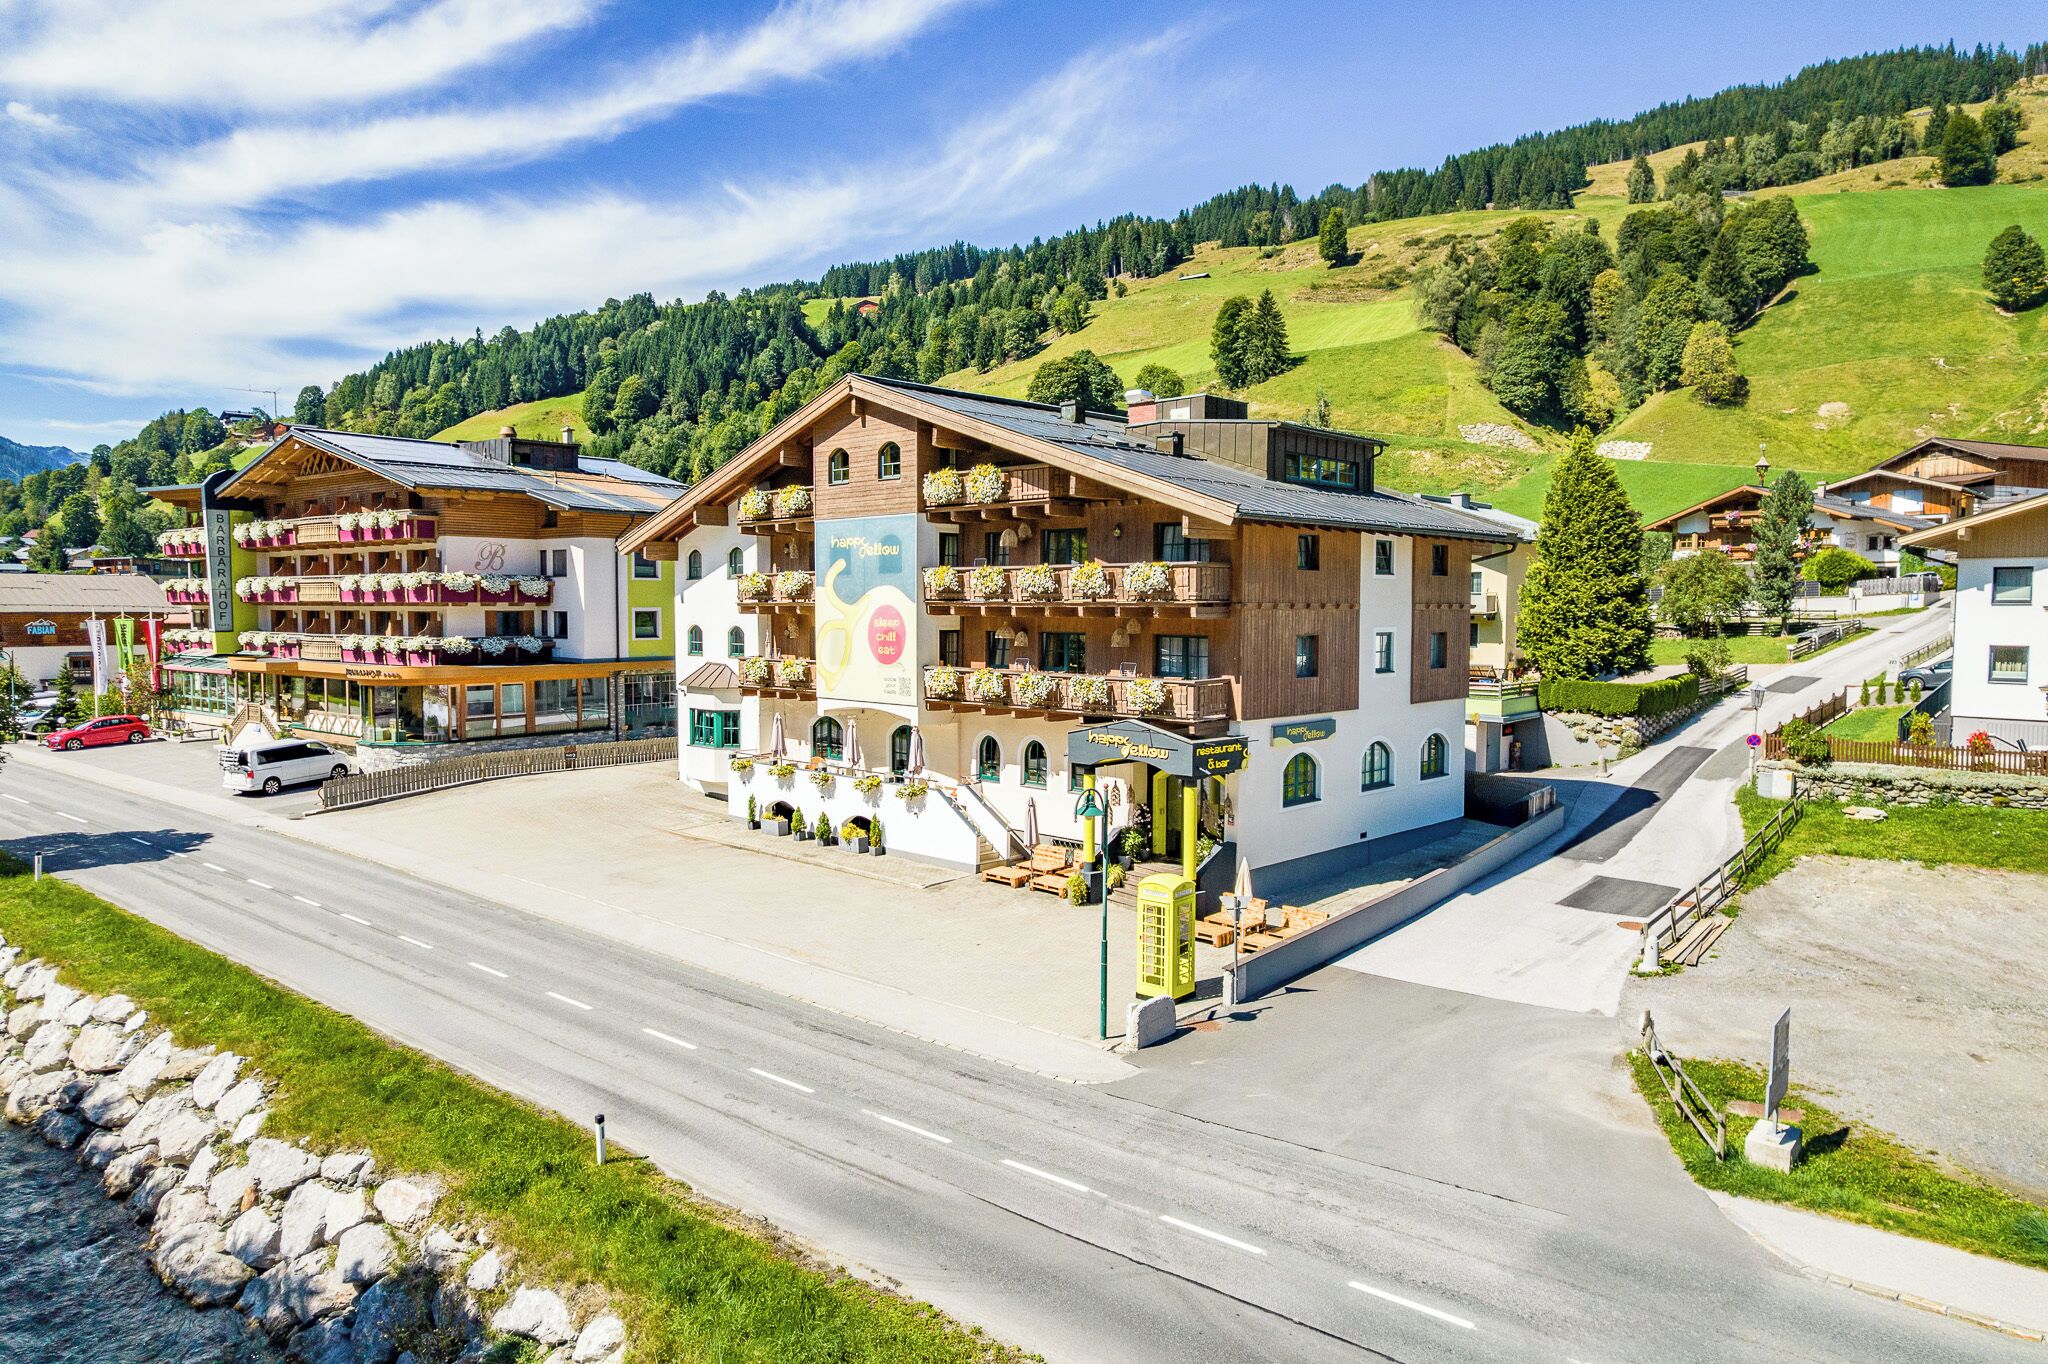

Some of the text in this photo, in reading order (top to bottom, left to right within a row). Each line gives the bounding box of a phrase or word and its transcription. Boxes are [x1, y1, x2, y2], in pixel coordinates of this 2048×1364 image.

[831, 535, 900, 559] happy yellow
[216, 514, 228, 620] BARBARAHOF
[873, 617, 900, 629] sleep
[27, 625, 55, 635] FABIAN
[876, 631, 896, 641] chill
[877, 646, 895, 655] eat
[1287, 726, 1325, 741] happy yellow
[1088, 730, 1169, 759] happy yellow
[1196, 743, 1243, 756] restaurant
[1207, 758, 1230, 769] & bar
